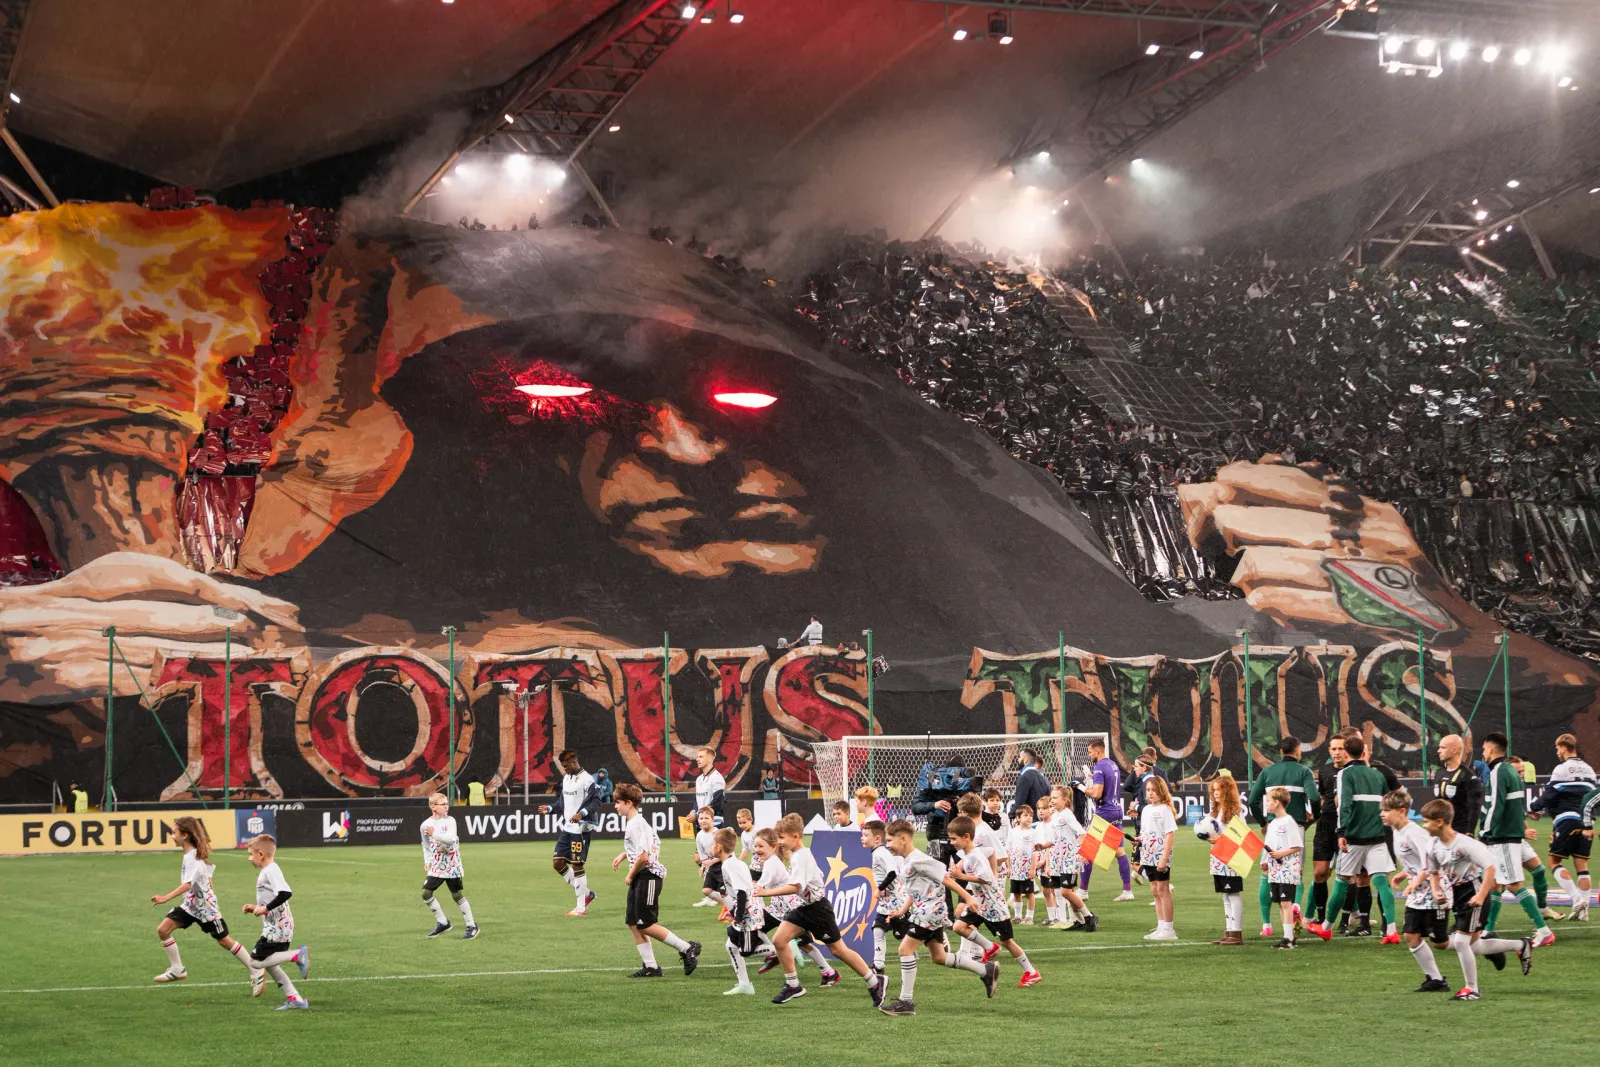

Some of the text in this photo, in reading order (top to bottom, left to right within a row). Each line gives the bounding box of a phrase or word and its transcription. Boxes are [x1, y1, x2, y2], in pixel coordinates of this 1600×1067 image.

[141, 641, 1473, 801] TOTUS TUUS
[571, 841, 583, 853] 59
